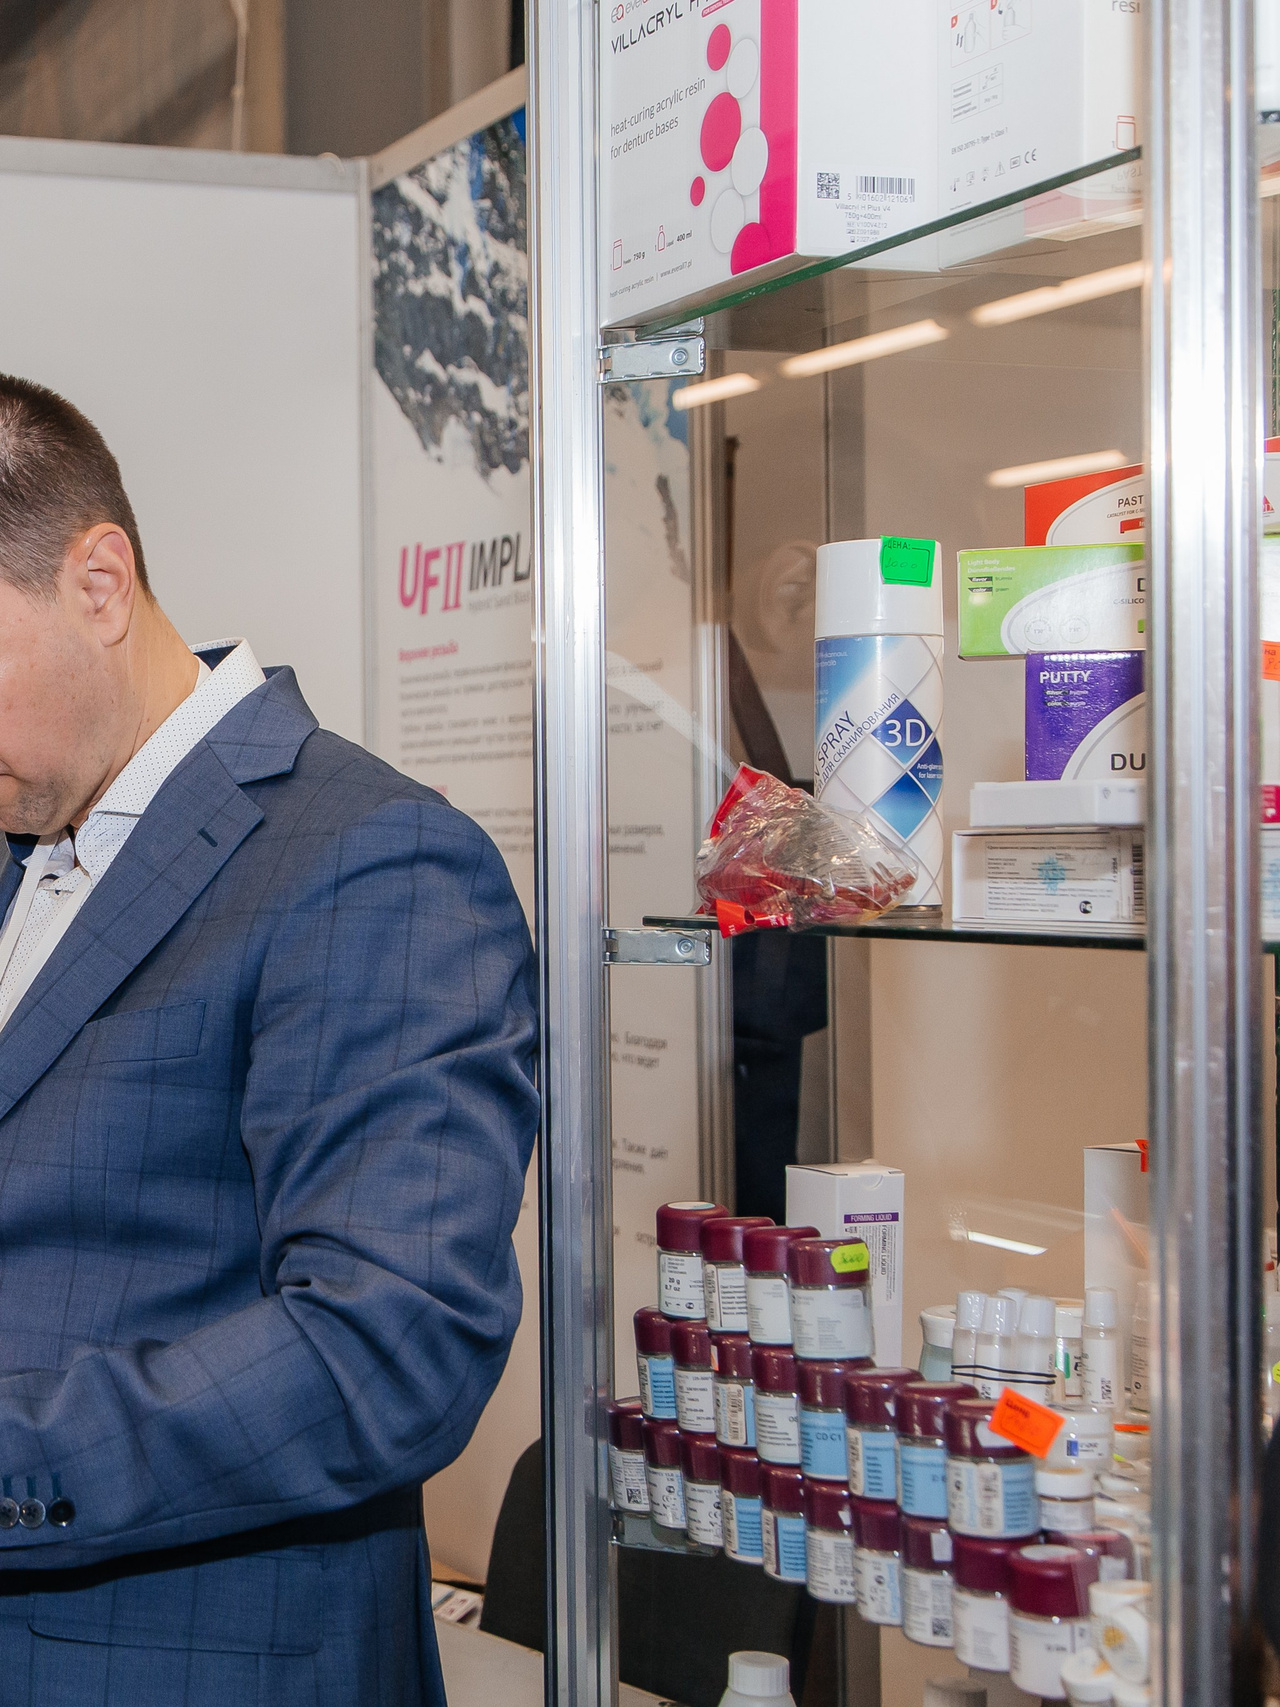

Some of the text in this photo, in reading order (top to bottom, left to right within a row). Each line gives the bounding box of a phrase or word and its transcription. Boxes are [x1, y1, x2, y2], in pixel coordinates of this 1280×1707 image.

[611, 1, 683, 54] VILLACRYL
[610, 77, 706, 138] heat-curing acrylic resin
[610, 115, 679, 160] for denture bases
[887, 540, 911, 550] ЦЕНА:
[1040, 669, 1092, 683] PUTTY
[817, 710, 855, 768] SPRAY
[822, 761, 836, 781] ДЛЯ
[833, 692, 901, 763] СКАНИРОВАНИЯ
[884, 718, 926, 747] 3D
[850, 1214, 892, 1222] FORMING LIQUID
[880, 1254, 888, 1276] LIQUID
